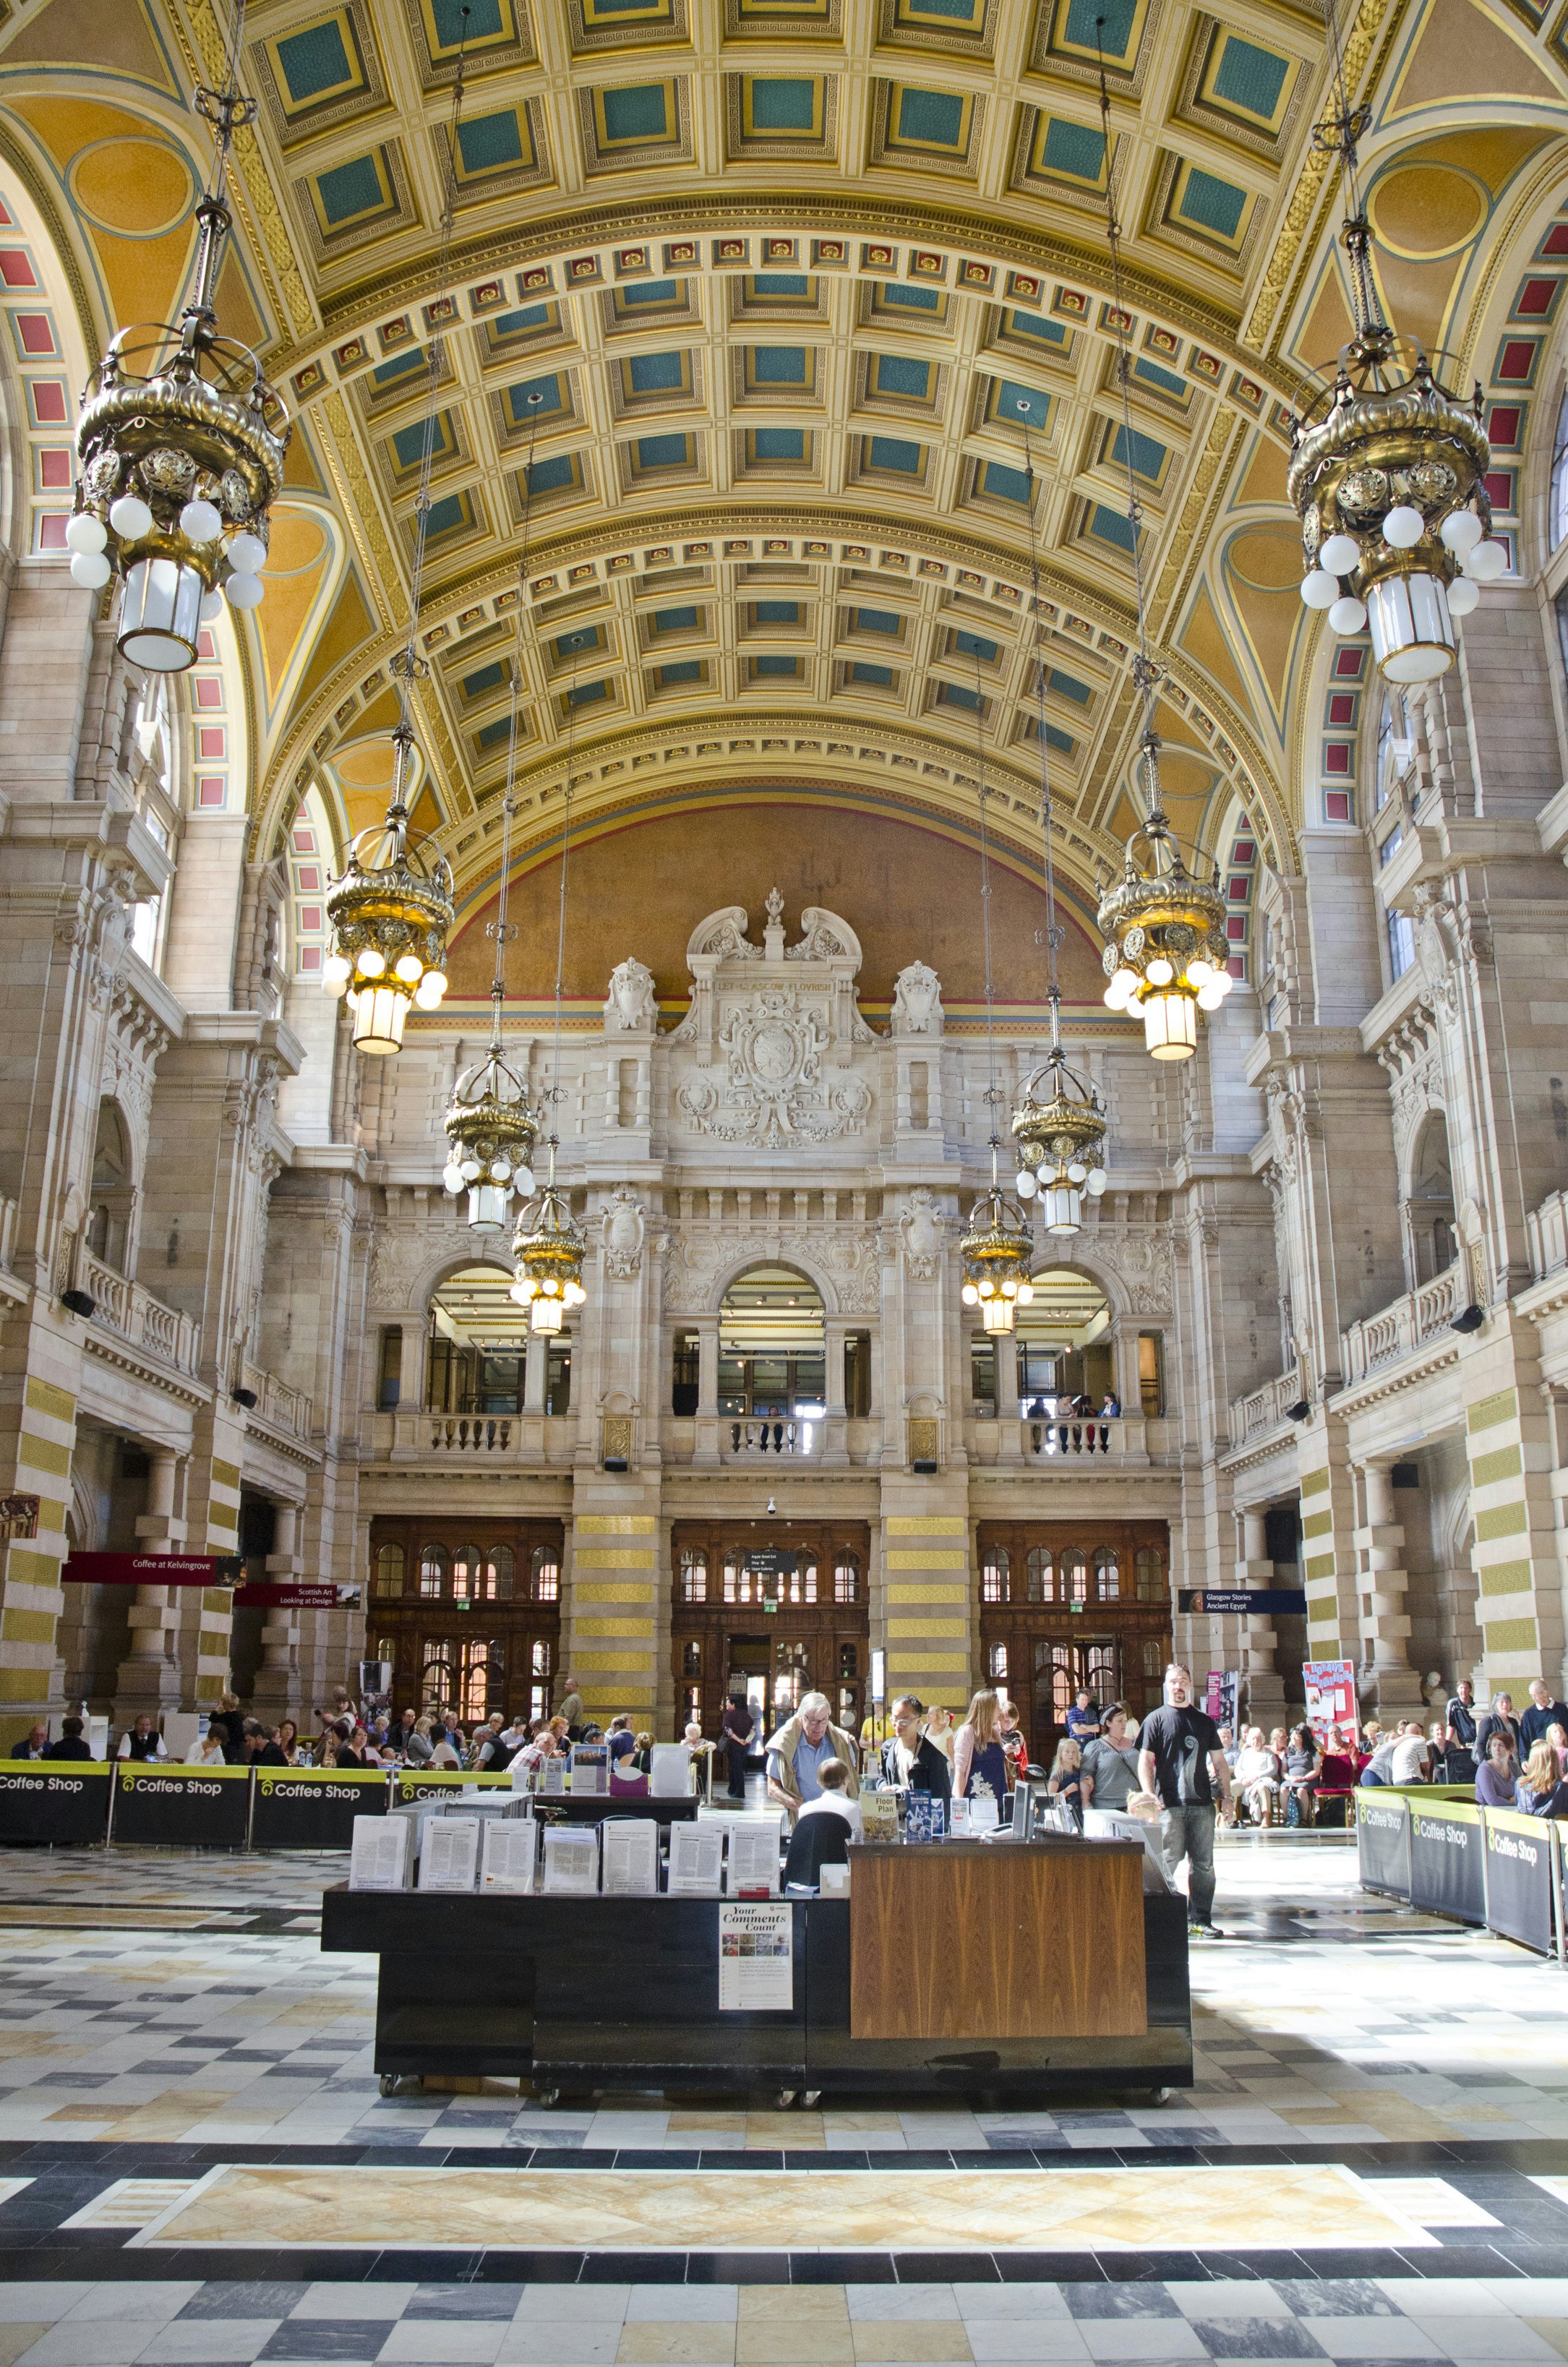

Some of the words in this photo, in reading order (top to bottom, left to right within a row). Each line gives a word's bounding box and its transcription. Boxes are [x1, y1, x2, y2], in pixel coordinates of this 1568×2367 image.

[132, 1559, 157, 1568] Coffee
[167, 1561, 210, 1571] Kelvingrove
[1207, 1593, 1230, 1602] Glasgow
[0, 1776, 44, 1790] Coffee
[48, 1778, 83, 1793] Shop
[136, 1779, 183, 1793] Coffee
[187, 1781, 222, 1797] Shop
[275, 1784, 322, 1798] Coffee
[325, 1785, 361, 1801] Shop
[416, 1787, 463, 1799] Coffee
[1366, 1810, 1387, 1827] Coffee
[1387, 1812, 1402, 1832] Shop
[1421, 1820, 1445, 1842] Coffee
[1447, 1825, 1467, 1849] Shop
[1494, 1833, 1517, 1857] Coffee
[1518, 1839, 1537, 1866] Shop
[723, 1913, 787, 1923] Comments
